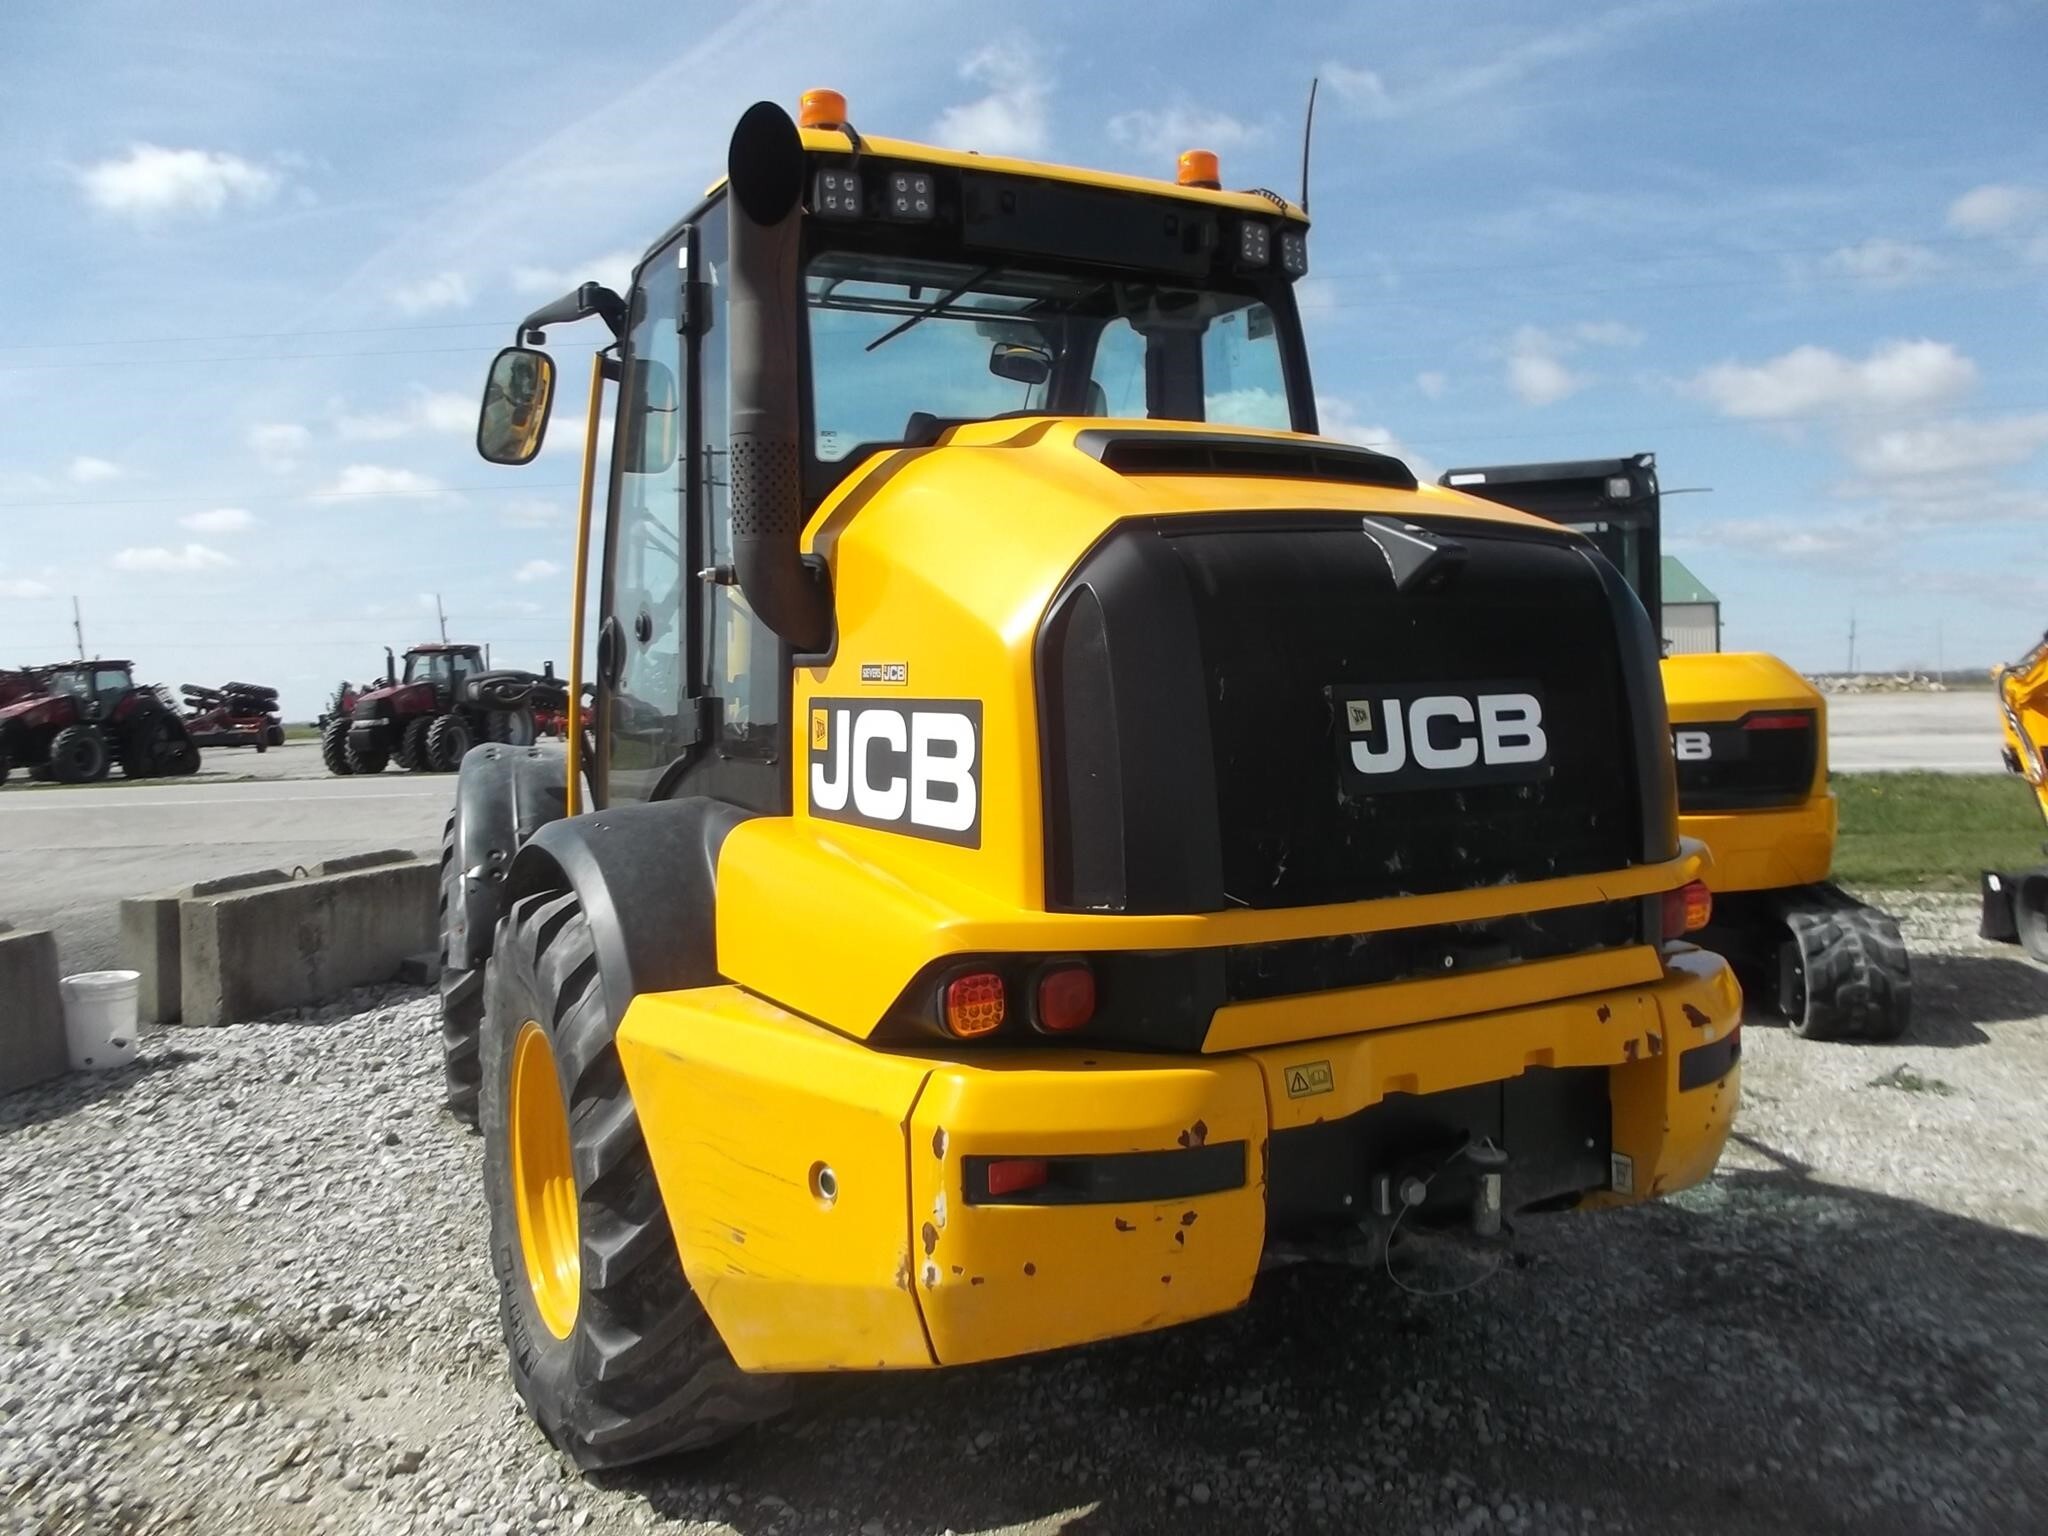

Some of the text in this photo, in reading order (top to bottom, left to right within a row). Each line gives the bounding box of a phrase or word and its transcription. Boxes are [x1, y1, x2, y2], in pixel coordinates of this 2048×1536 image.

[883, 665, 905, 681] JCB
[811, 709, 977, 832] JCB
[1350, 693, 1548, 774] JCB
